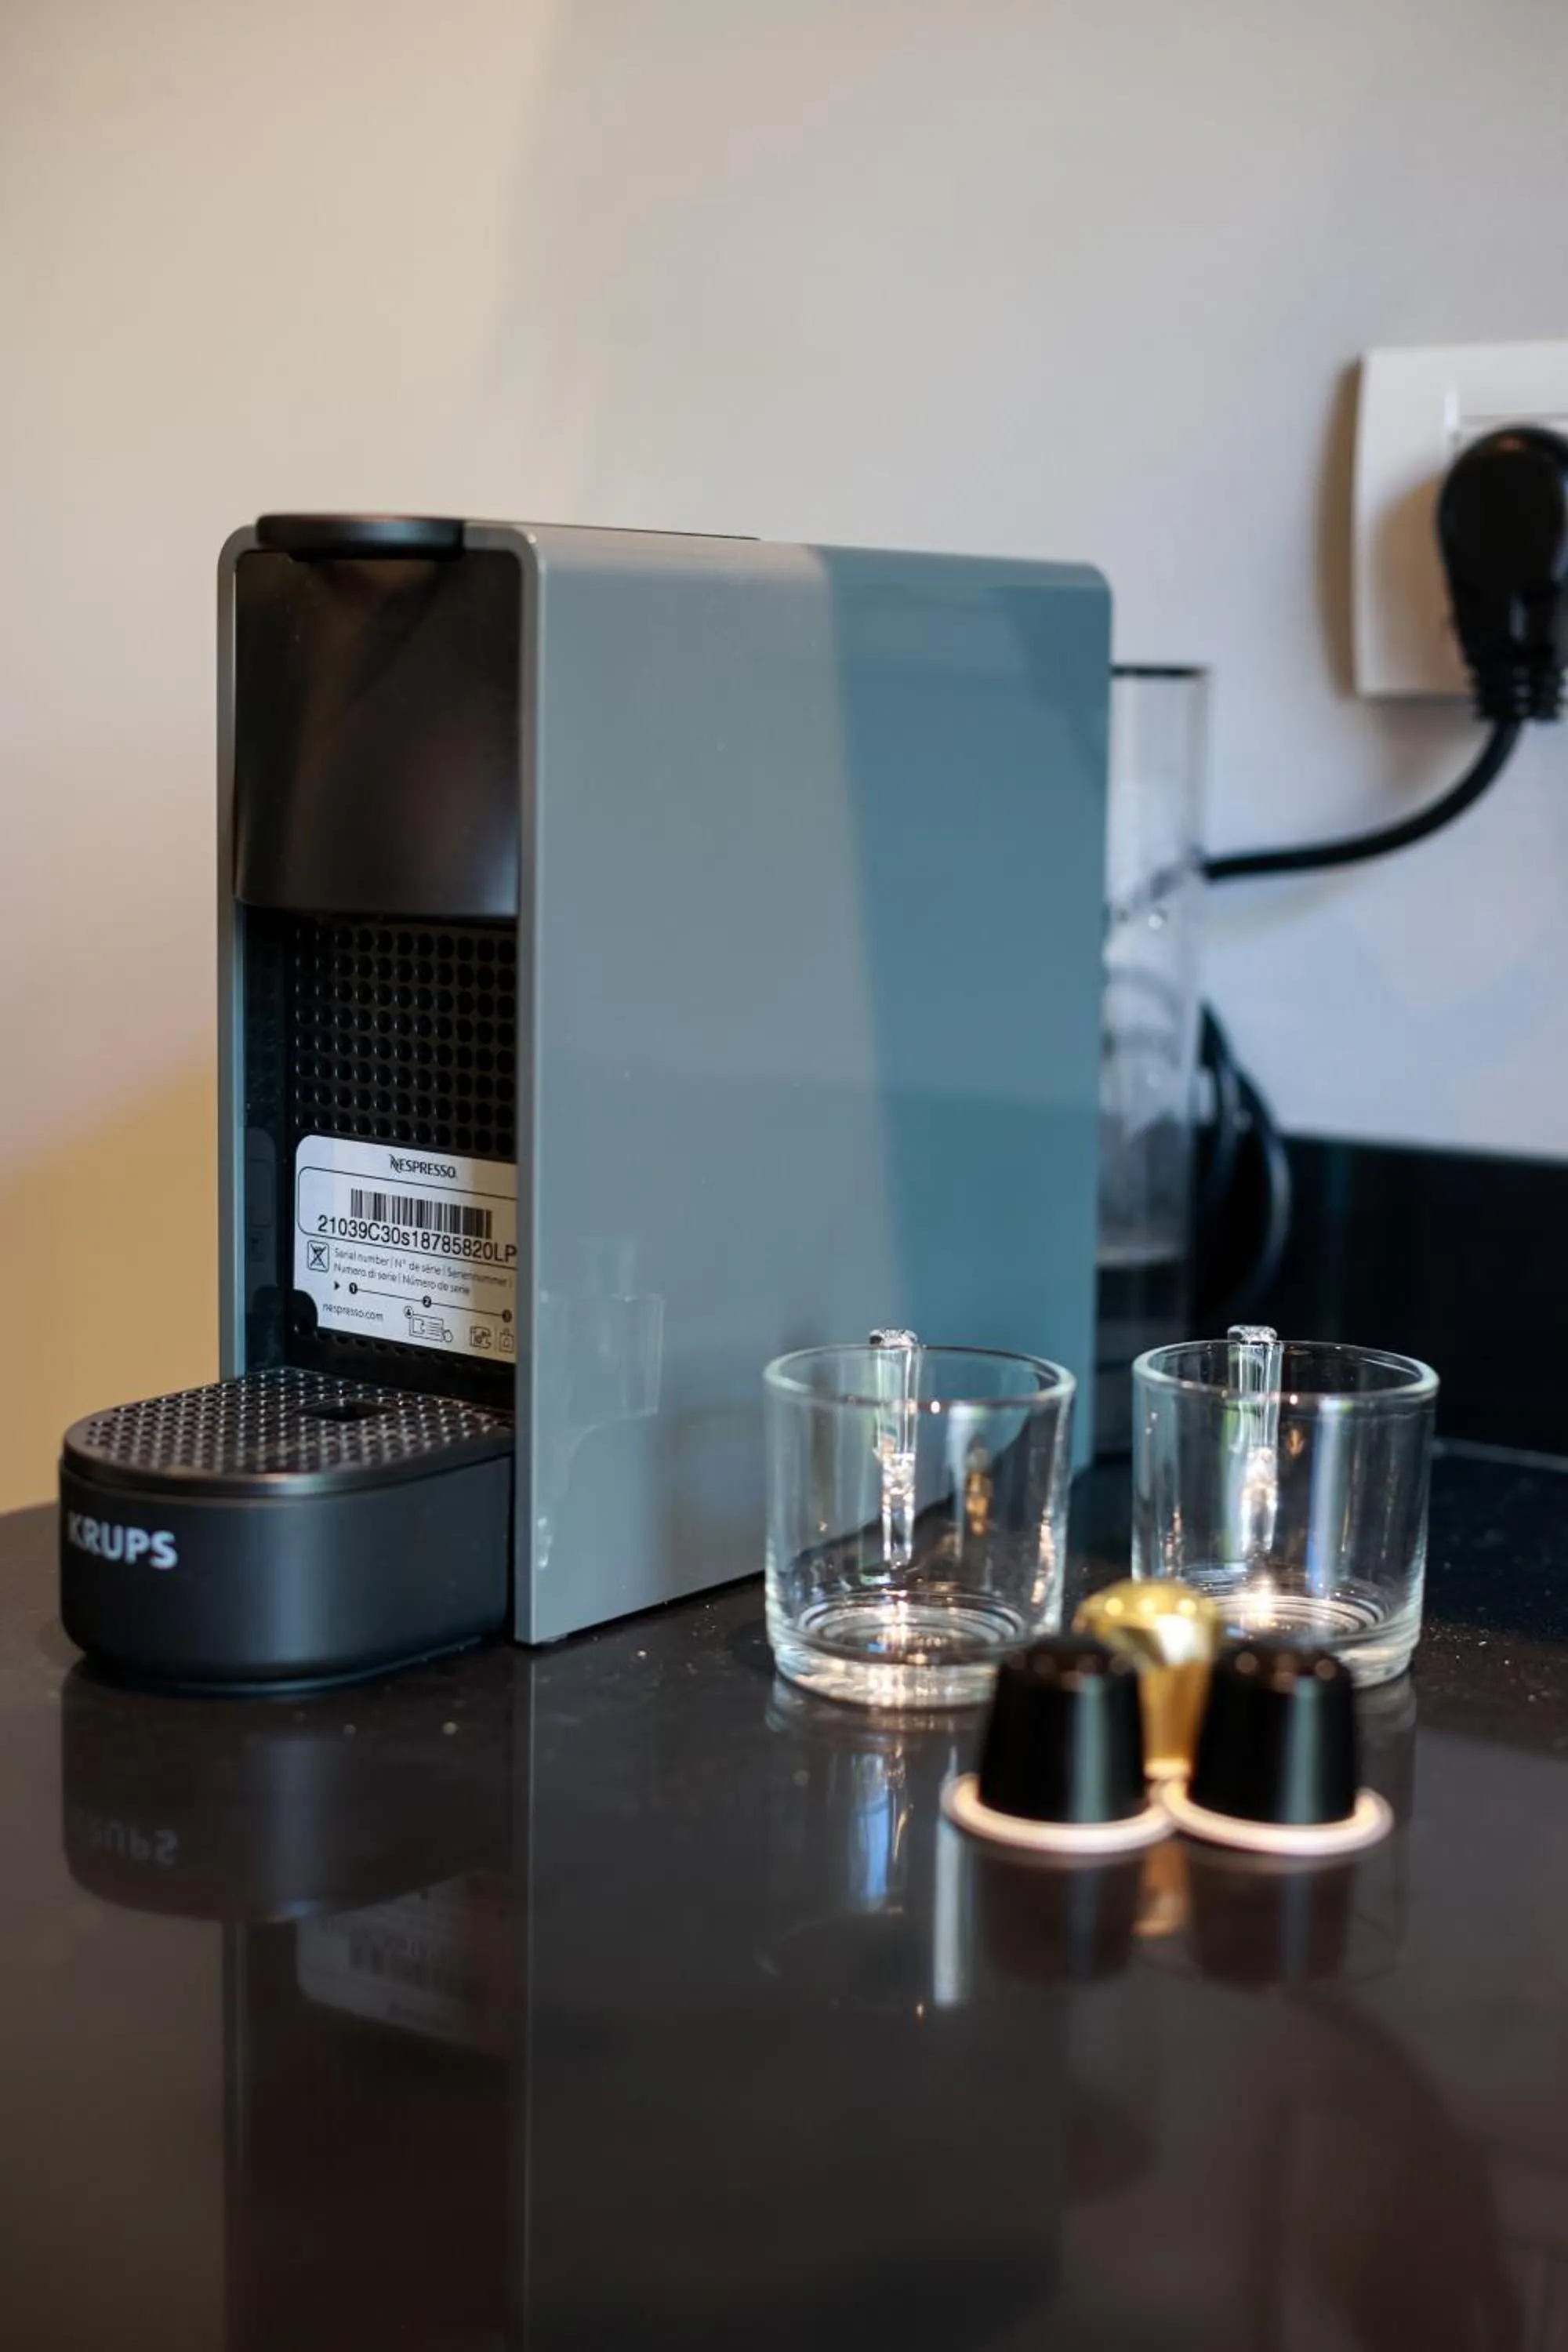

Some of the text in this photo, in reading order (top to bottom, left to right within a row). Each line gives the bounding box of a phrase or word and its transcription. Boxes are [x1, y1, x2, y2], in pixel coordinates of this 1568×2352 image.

[389, 1153, 456, 1179] NESPRESSO
[358, 1254, 390, 1266] number
[409, 1261, 420, 1272] de
[322, 1303, 384, 1322] nespresso.com
[67, 1510, 178, 1570] KRUPS
